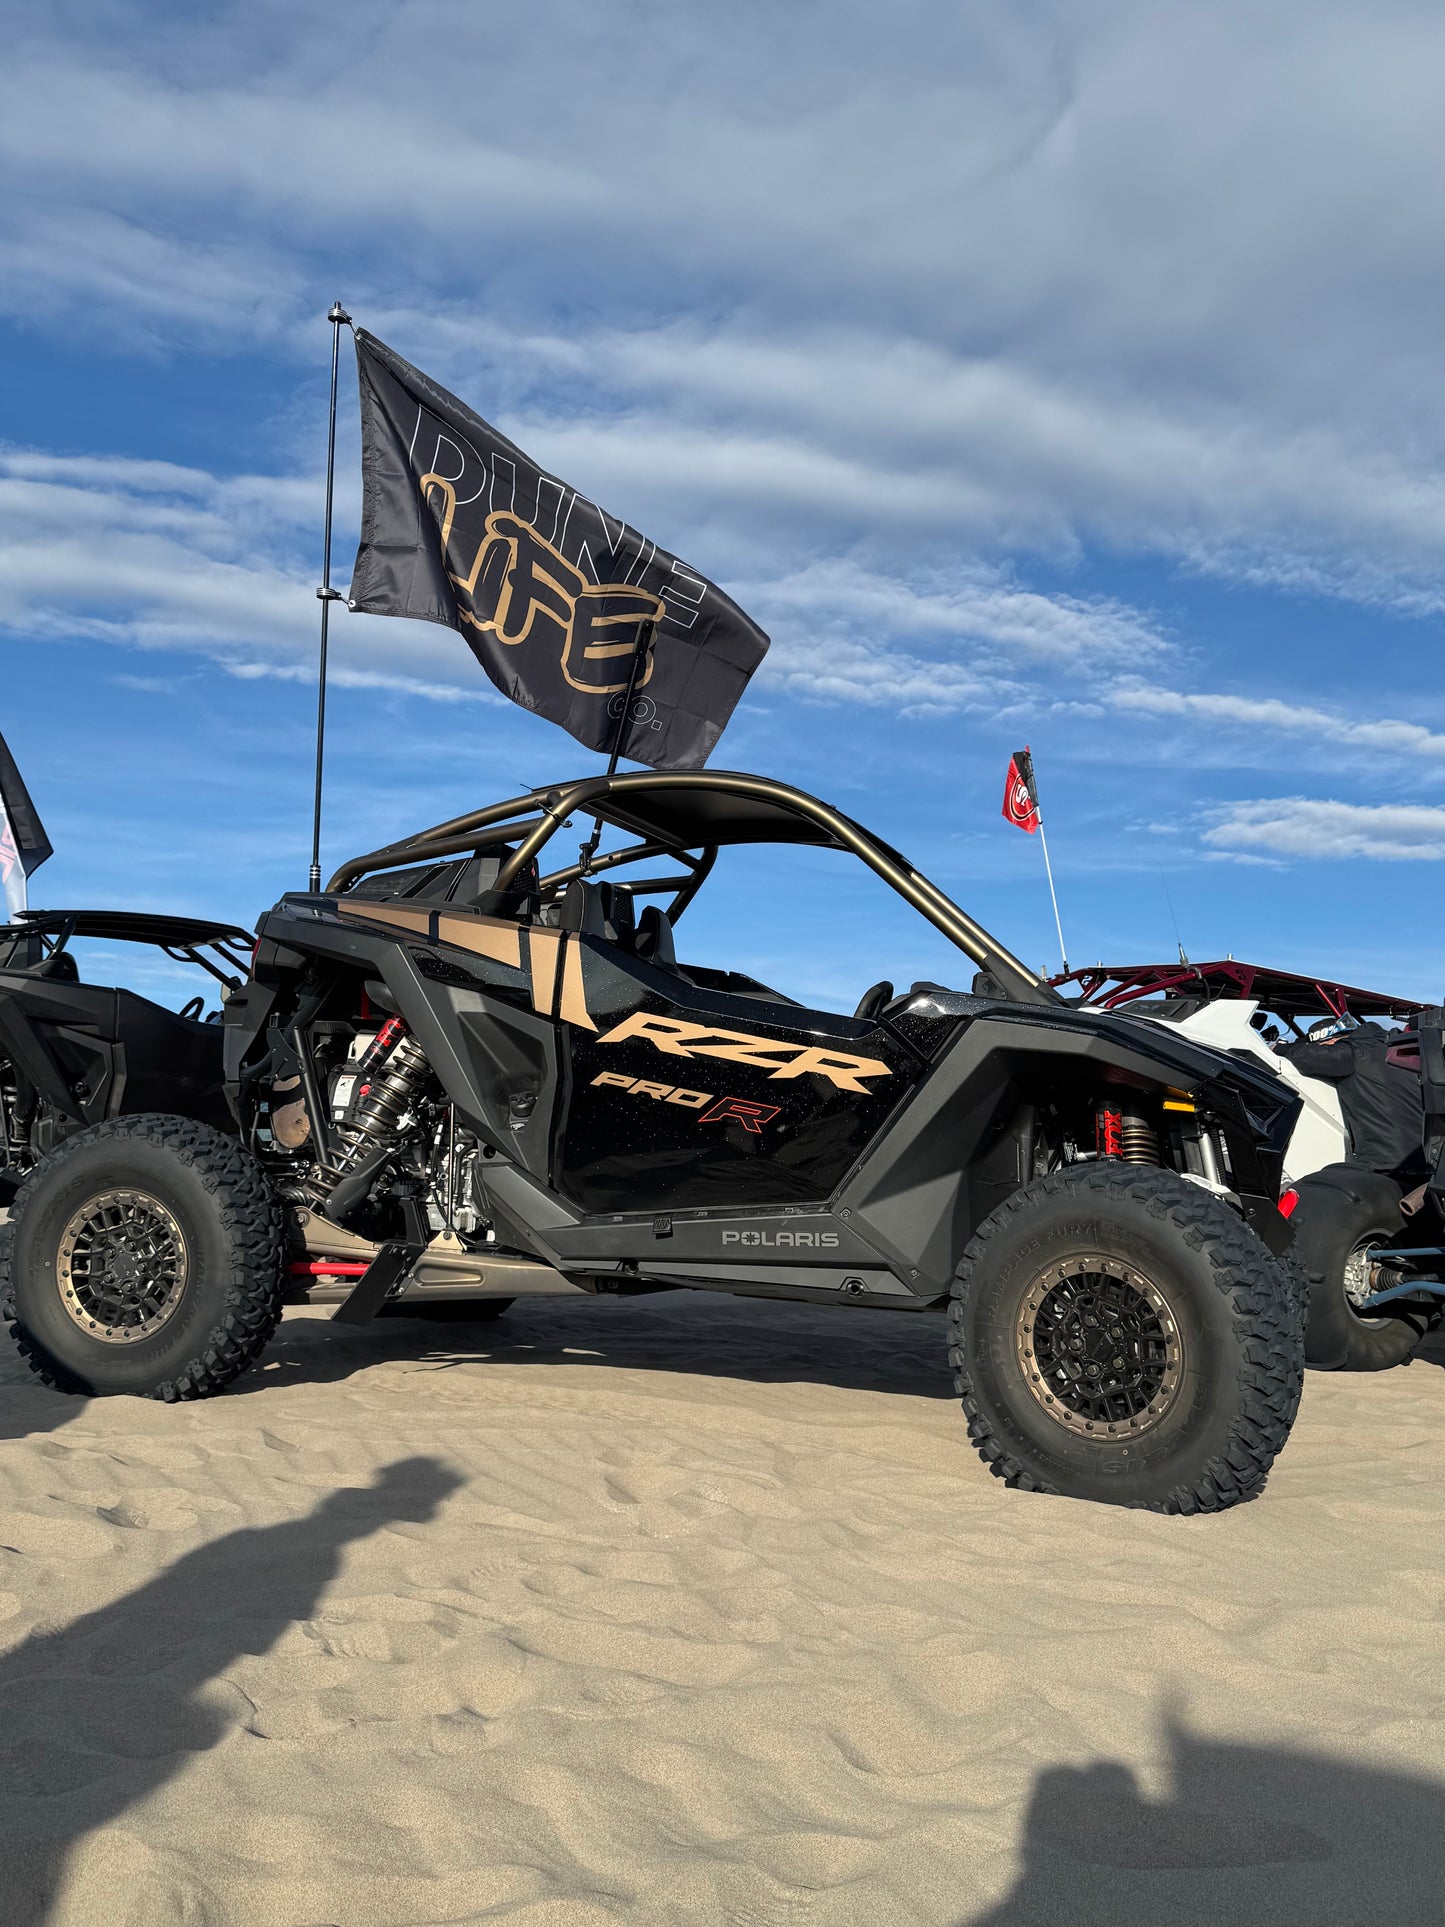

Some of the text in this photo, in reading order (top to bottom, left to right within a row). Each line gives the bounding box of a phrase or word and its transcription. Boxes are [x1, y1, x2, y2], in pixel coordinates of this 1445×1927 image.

[409, 404, 707, 628] DUNE
[419, 472, 666, 694] LIFE
[595, 1011, 893, 1095] RZR
[590, 1071, 781, 1134] PRO R
[1103, 1109, 1123, 1157] FOX
[721, 1230, 840, 1247] POLARIS
